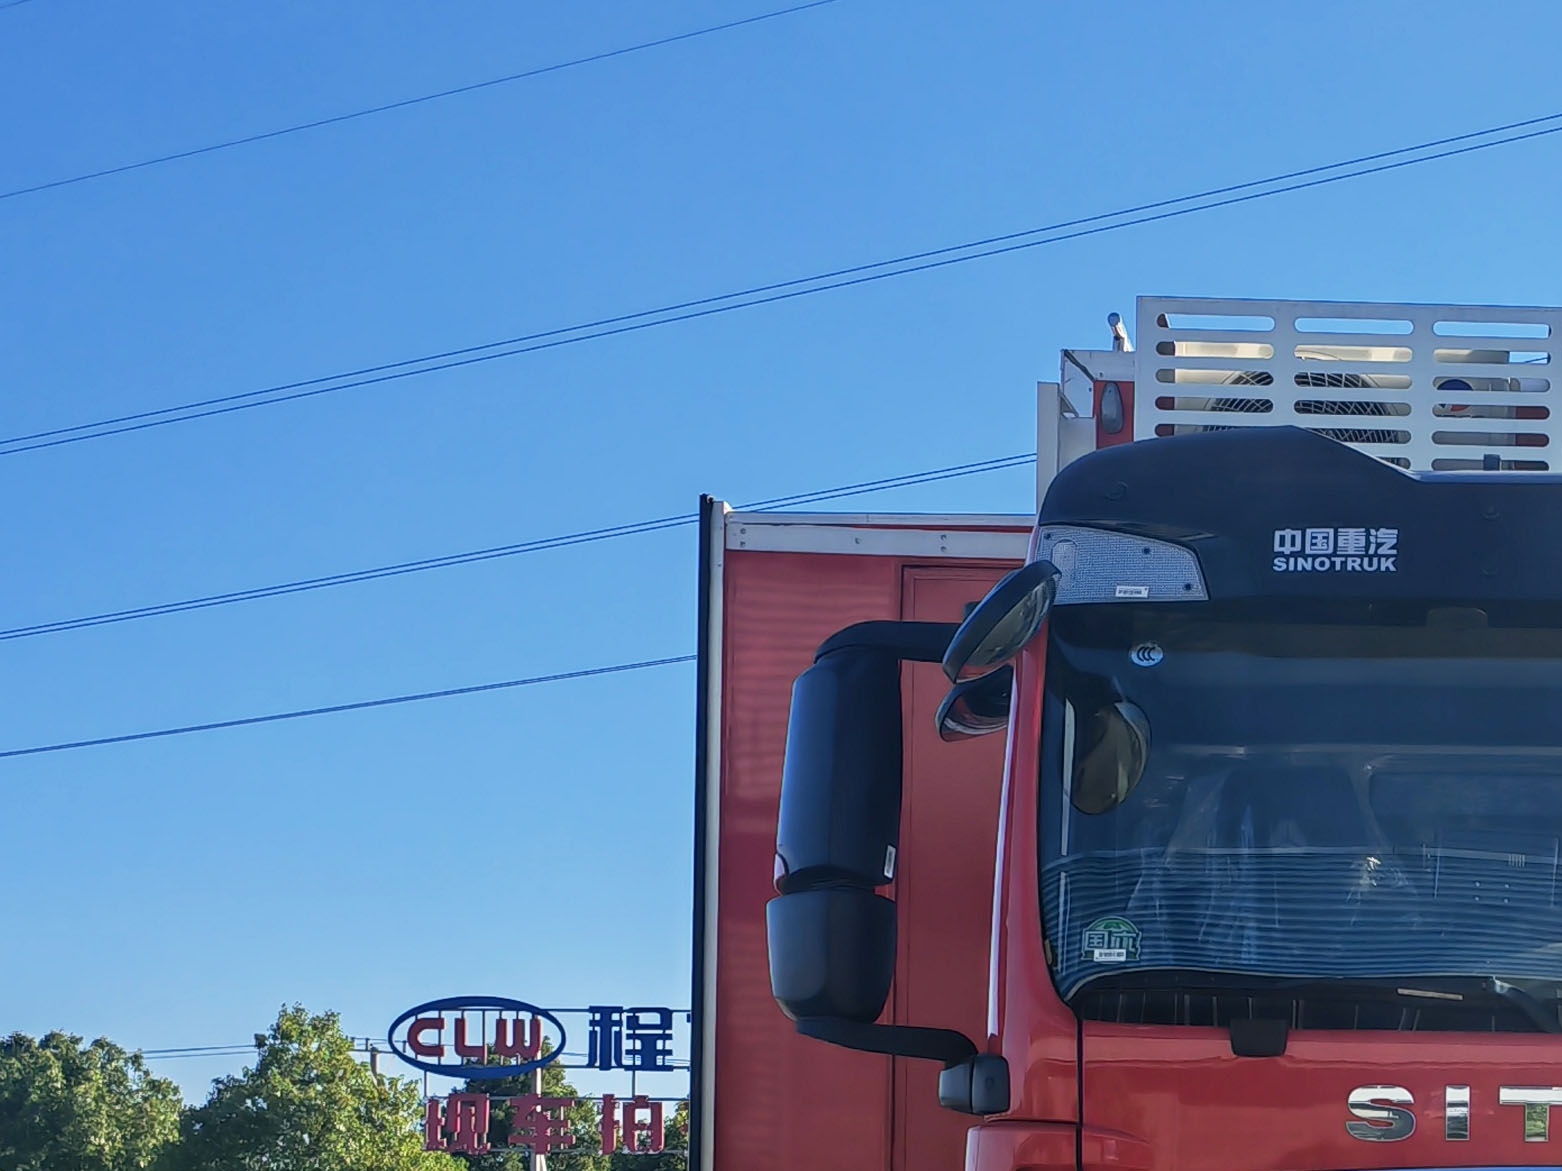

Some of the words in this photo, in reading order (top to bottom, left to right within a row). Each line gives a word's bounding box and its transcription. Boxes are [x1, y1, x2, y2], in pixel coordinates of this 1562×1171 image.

[1273, 527, 1399, 555] 中国重汽
[1272, 556, 1397, 572] SINOTRUK
[406, 1017, 542, 1058] CLW
[585, 1005, 690, 1072] 程
